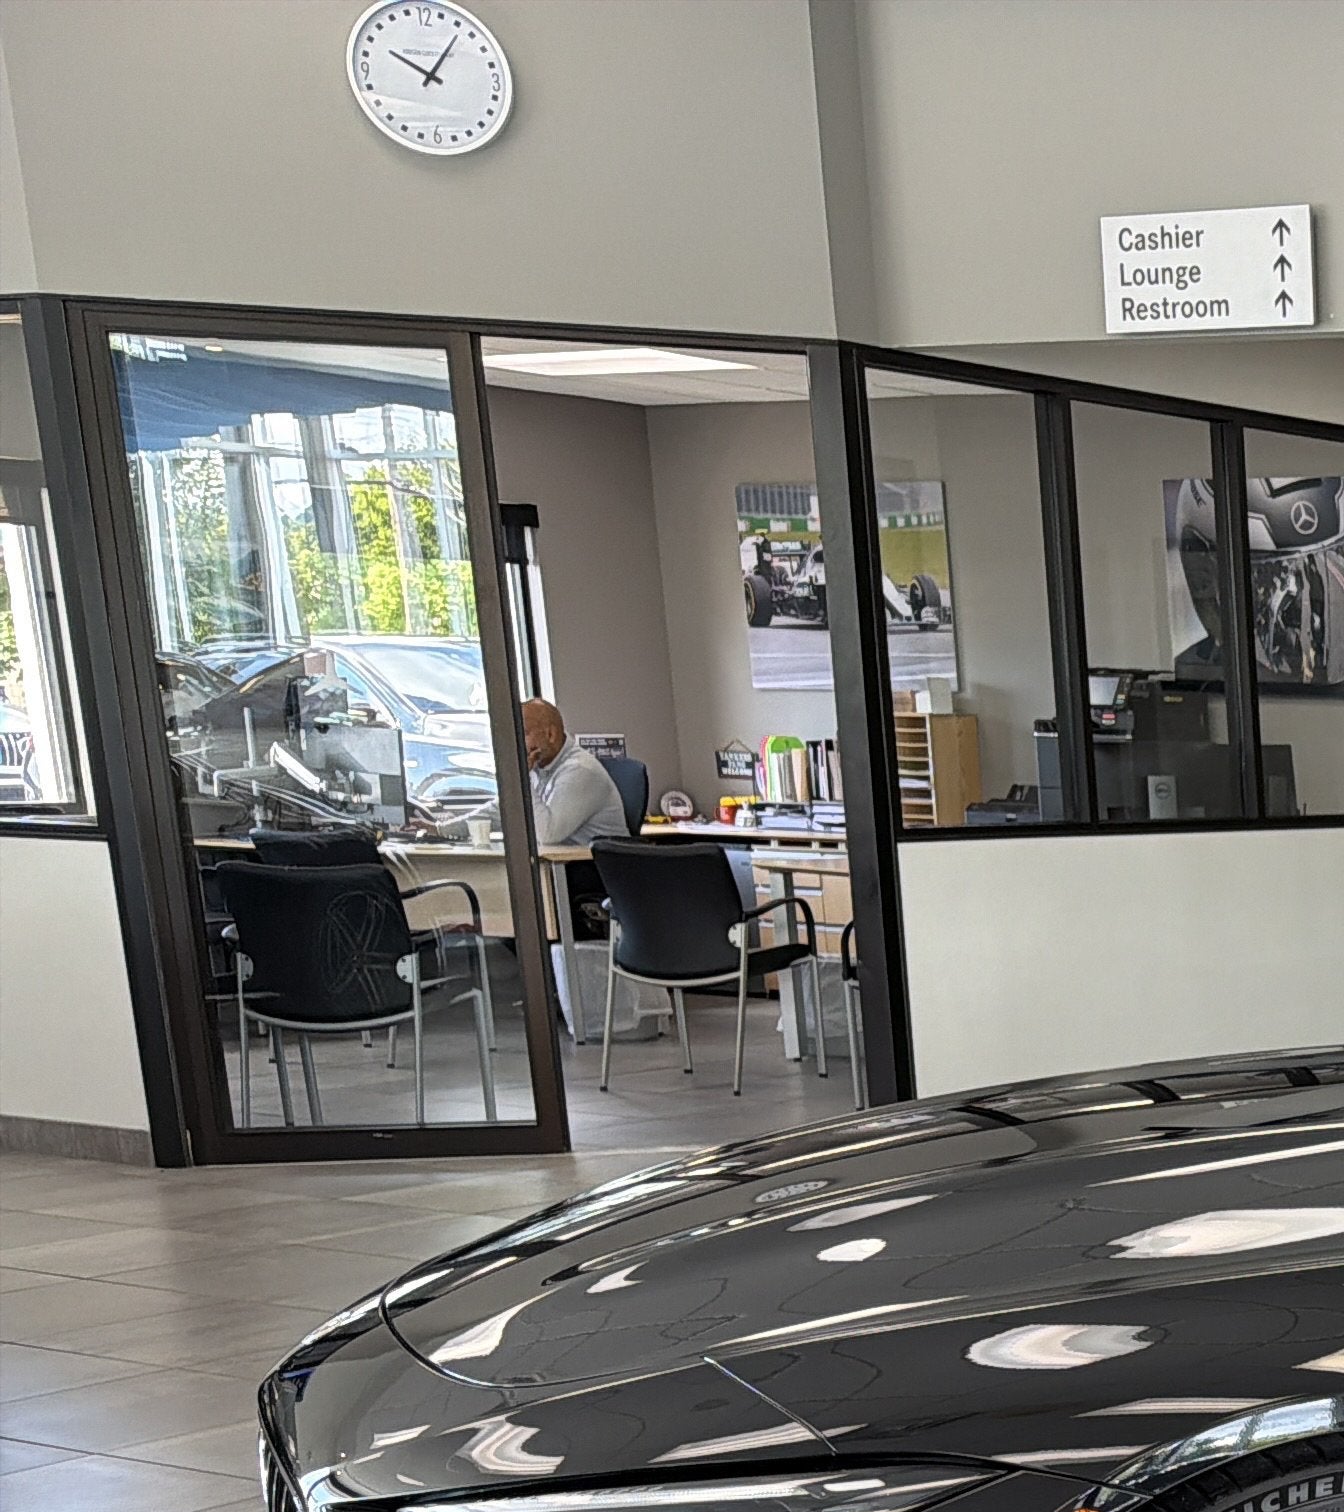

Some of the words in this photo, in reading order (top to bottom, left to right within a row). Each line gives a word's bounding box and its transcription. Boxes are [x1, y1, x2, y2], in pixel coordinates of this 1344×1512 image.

[416, 7, 432, 27] 12
[361, 61, 370, 80] 9
[492, 73, 500, 92] 3
[433, 125, 442, 144] 6
[1118, 224, 1205, 252] Cashier
[1120, 262, 1201, 290] Lounge
[1121, 297, 1230, 321] Restroom
